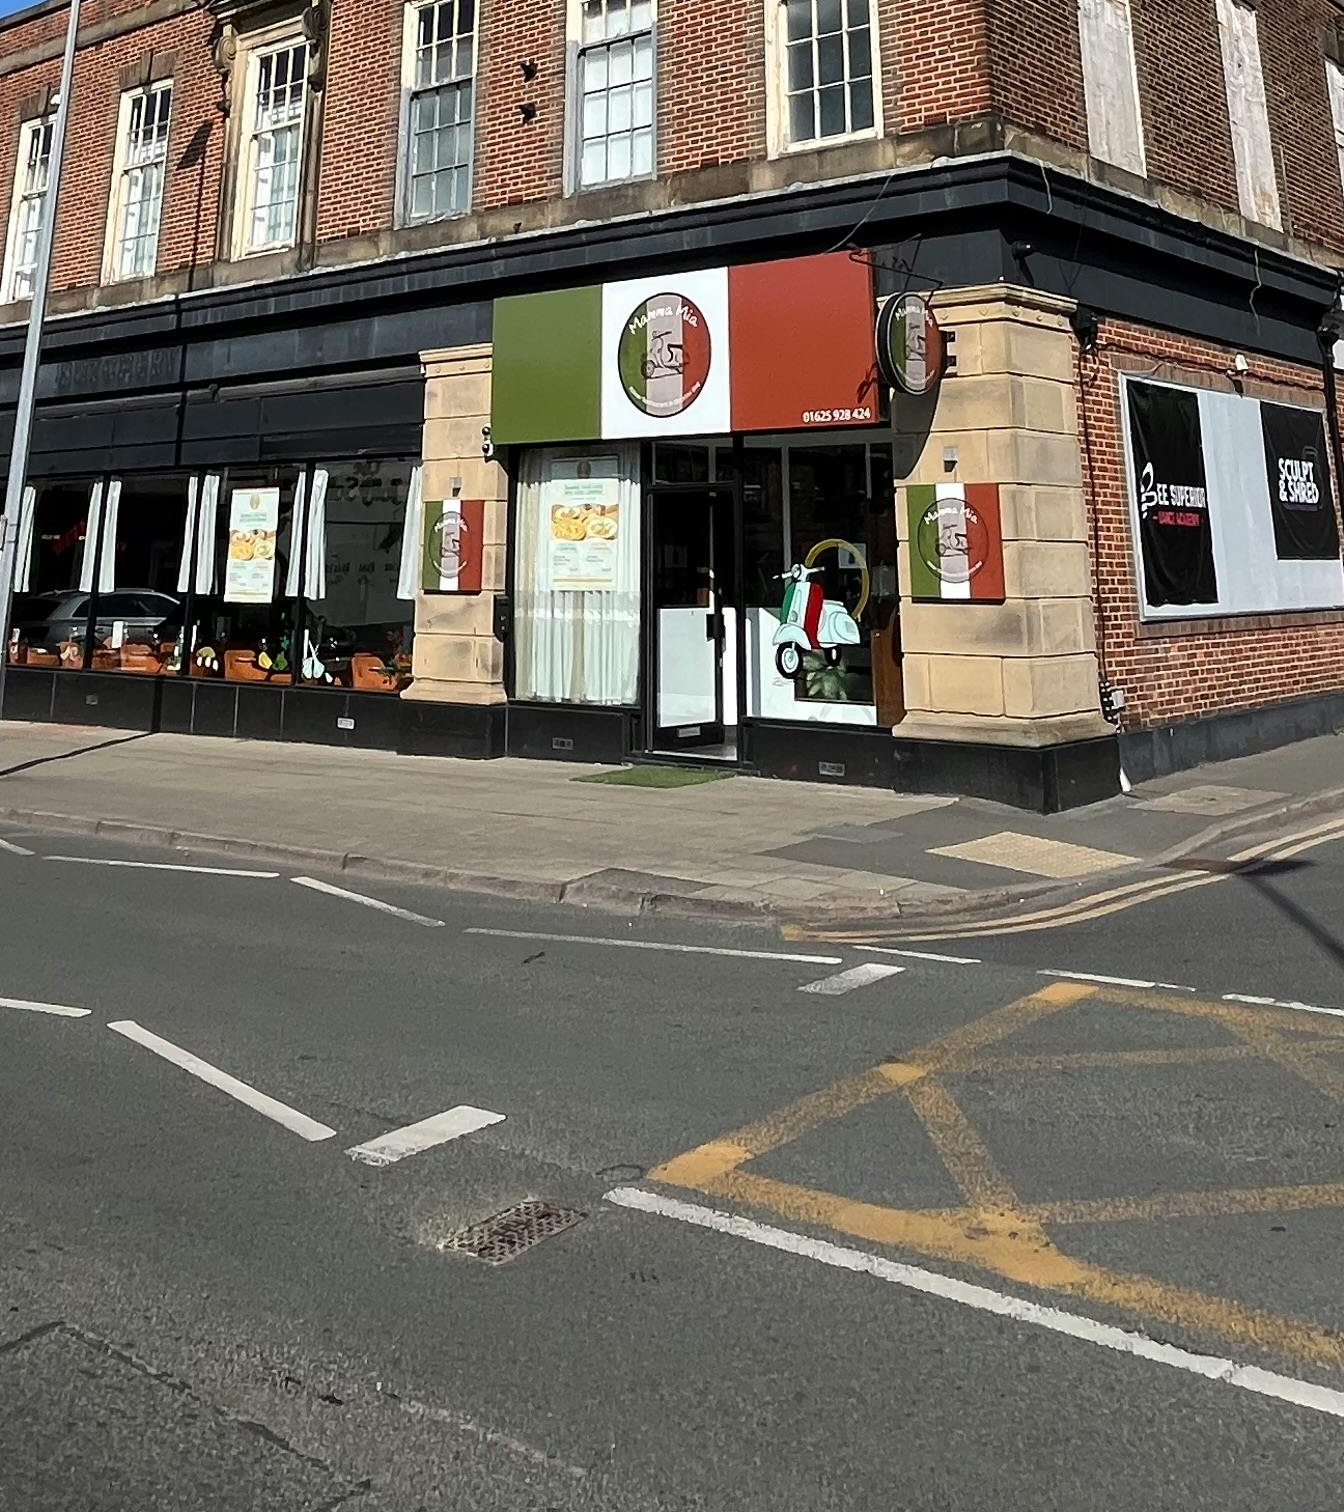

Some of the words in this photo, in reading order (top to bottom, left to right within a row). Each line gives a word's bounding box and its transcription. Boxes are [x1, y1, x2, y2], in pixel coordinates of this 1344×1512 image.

[628, 306, 674, 335] Mamma
[675, 304, 699, 328] Mia
[802, 409, 832, 423] 01625
[851, 407, 871, 420] 424
[1278, 457, 1314, 482] SCULPT
[1169, 484, 1207, 509] SUPERIOR
[1278, 479, 1288, 502] &
[1287, 481, 1320, 504] SHRED
